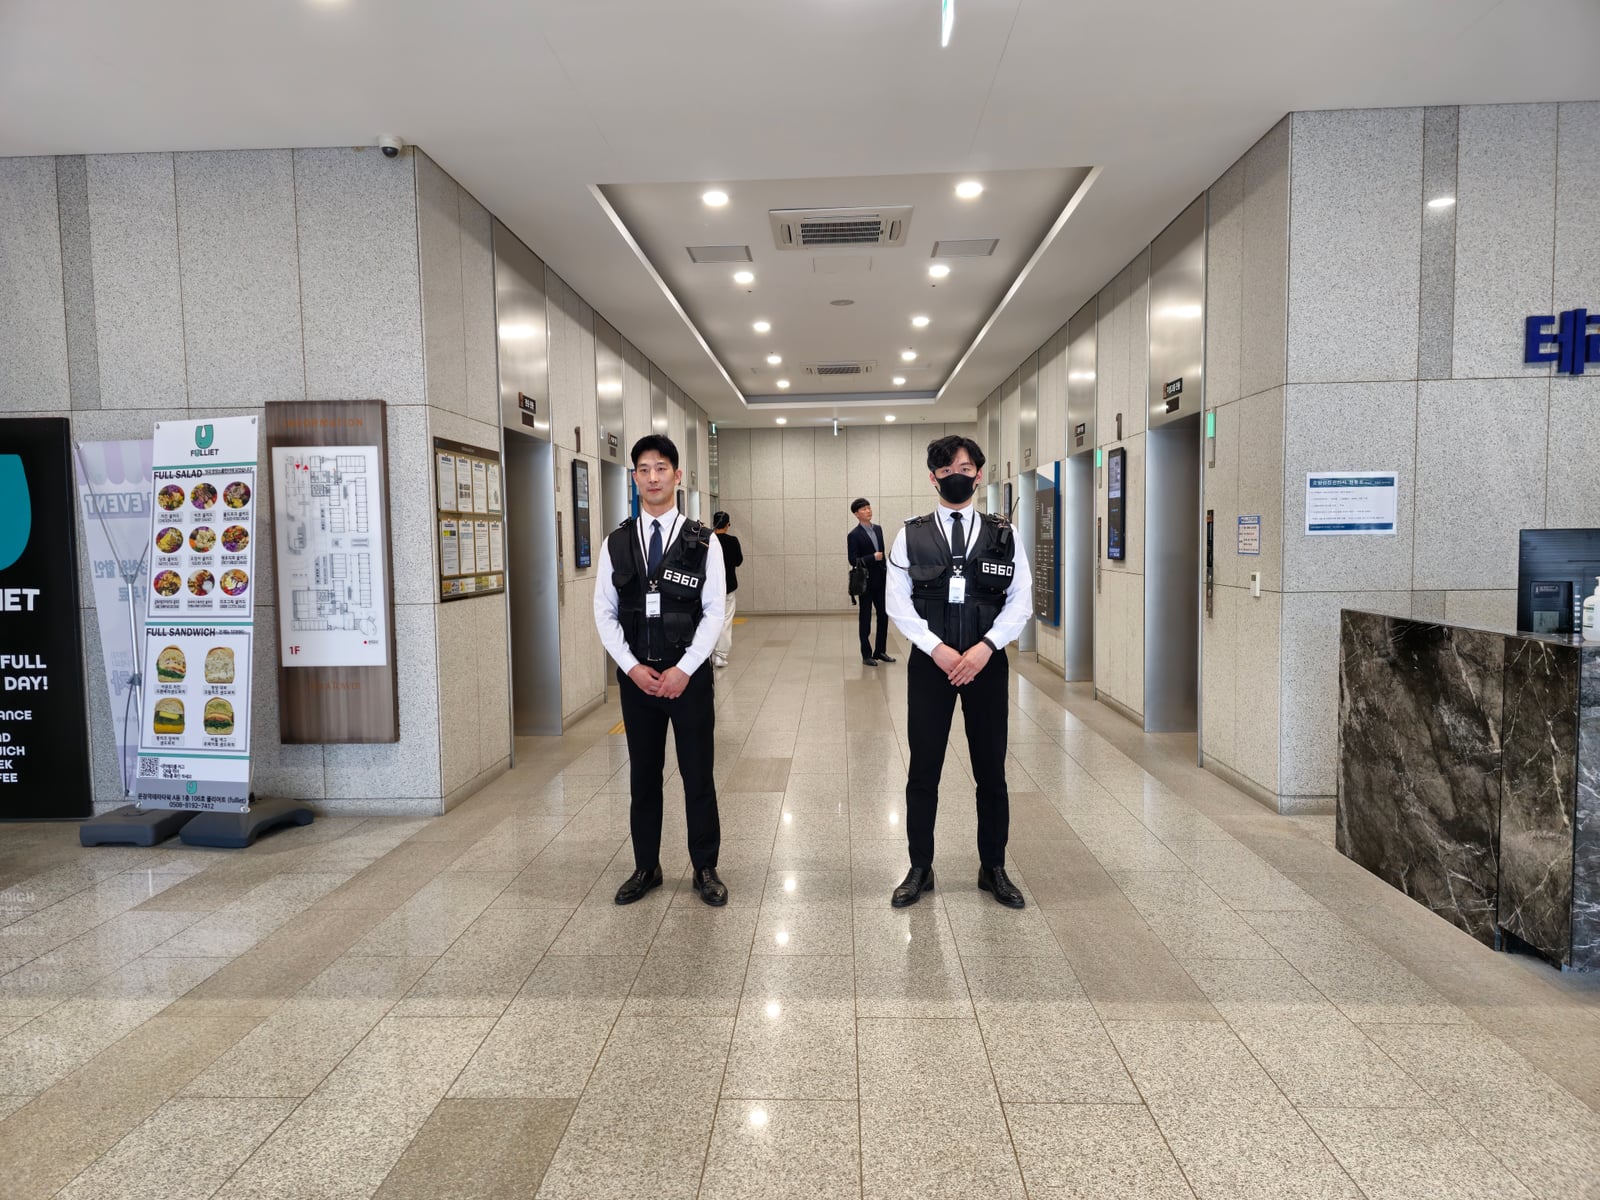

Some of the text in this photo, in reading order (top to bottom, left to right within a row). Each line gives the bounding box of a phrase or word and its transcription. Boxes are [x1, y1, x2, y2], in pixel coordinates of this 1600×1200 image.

[1525, 309, 1600, 375] 테
[153, 470, 173, 480] FULL
[175, 469, 203, 479] SALAD
[982, 562, 1013, 577] G360
[663, 569, 699, 589] G360
[146, 628, 167, 637] FULL
[169, 628, 216, 637] SANDWICH
[289, 646, 300, 655] 1F
[0, 654, 47, 669] FULL
[4, 676, 48, 690] DAY!
[0, 733, 11, 742] D
[0, 746, 25, 756] ICH
